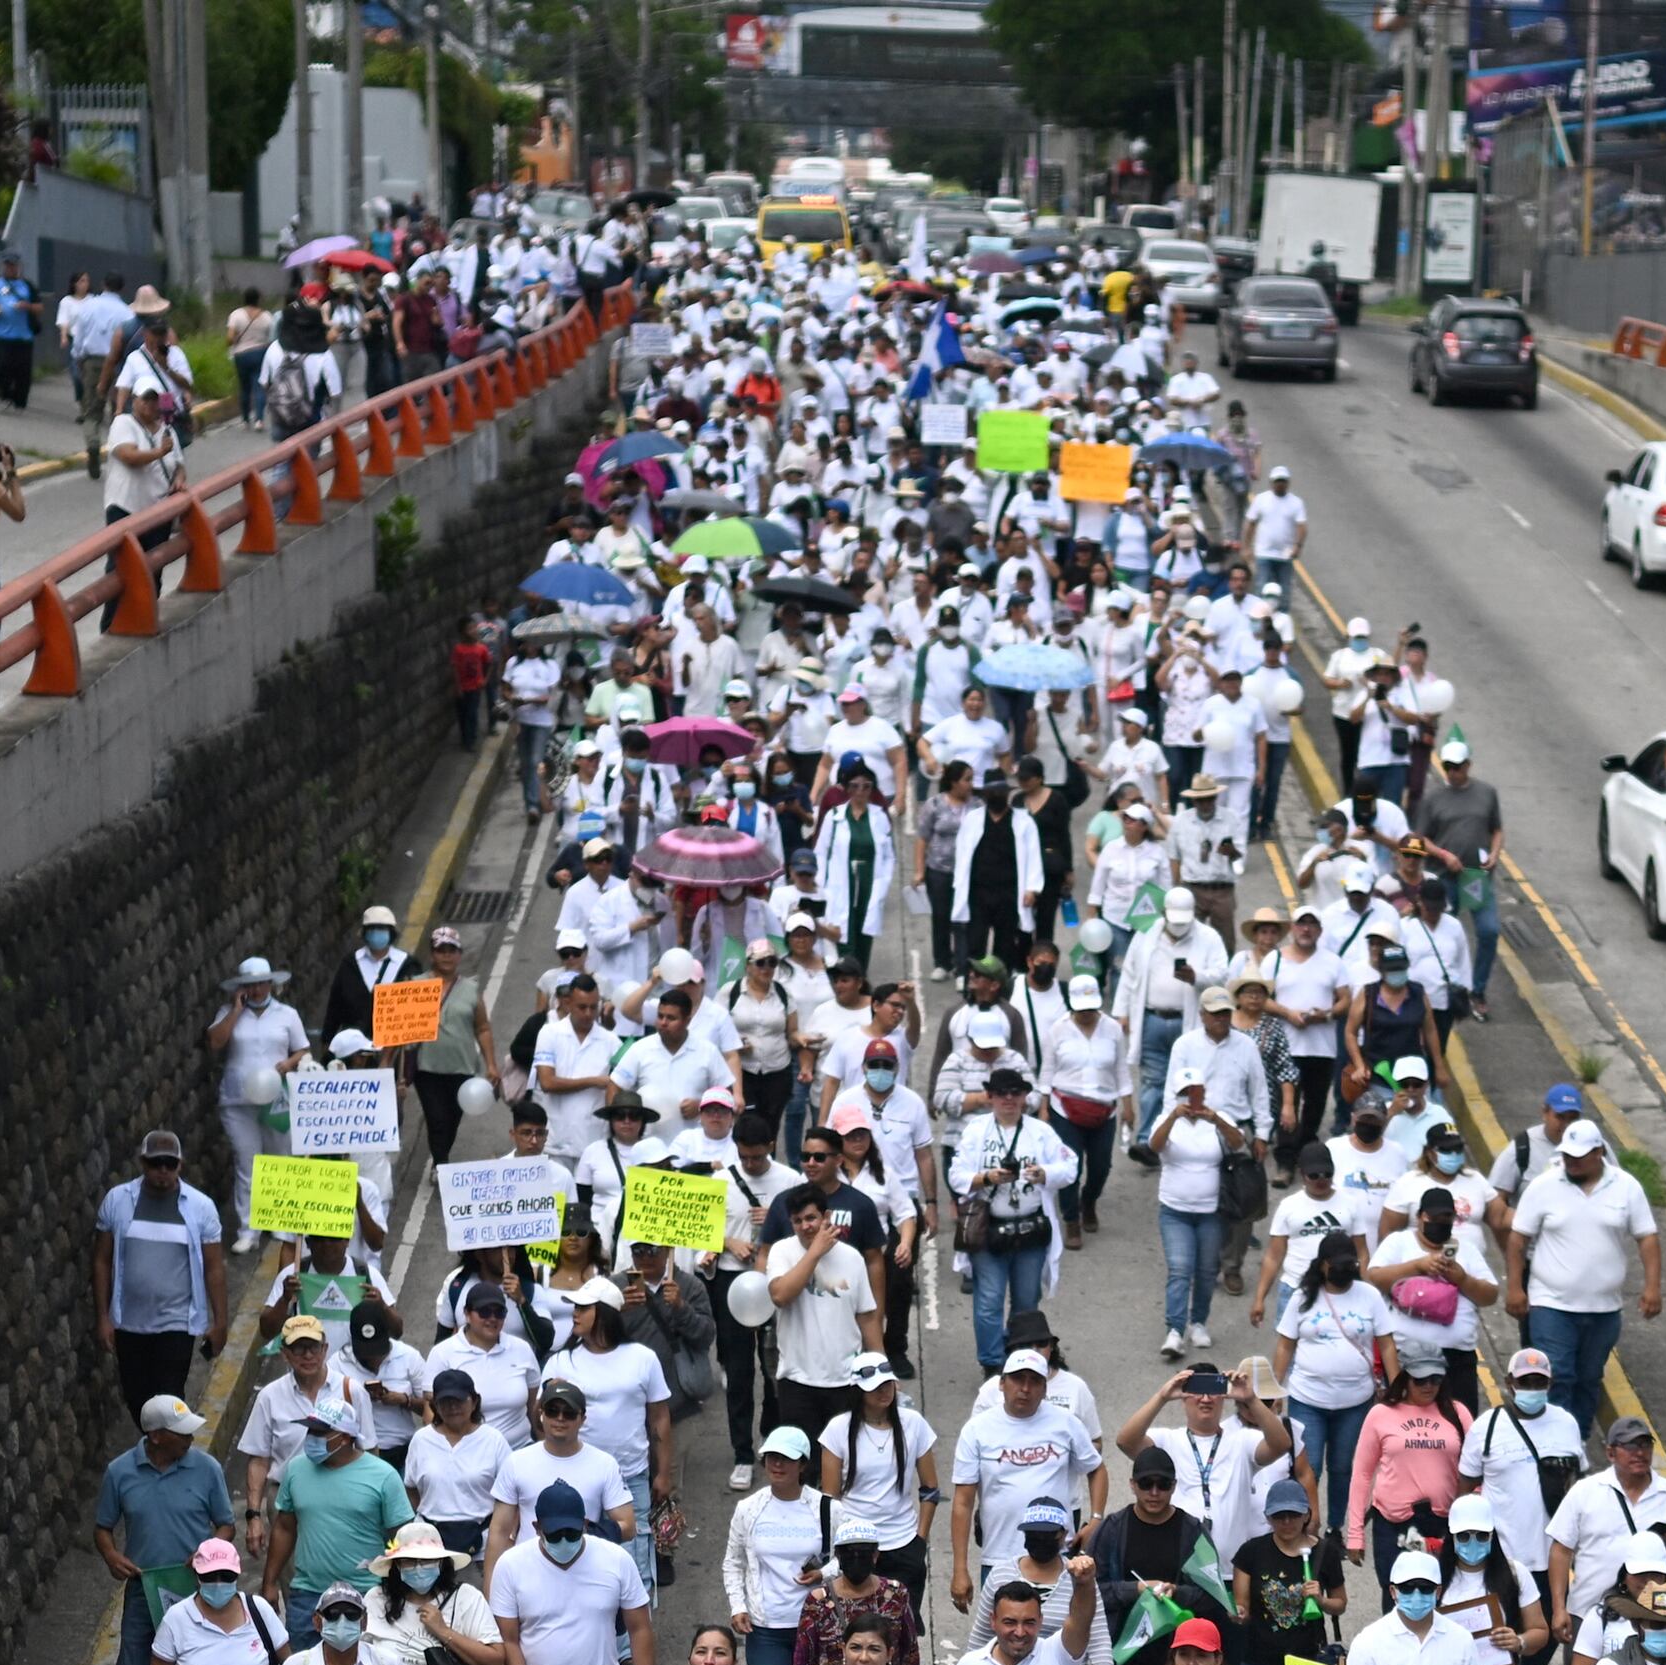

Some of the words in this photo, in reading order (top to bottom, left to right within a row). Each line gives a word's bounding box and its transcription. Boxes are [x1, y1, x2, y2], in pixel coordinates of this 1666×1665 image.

[298, 1080, 380, 1094] ESCALAFON
[298, 1099, 377, 1111] ESCALAFON
[297, 1115, 375, 1127] ESCALAFON
[660, 1176, 684, 1187] POR
[479, 1201, 512, 1214] SOMOS
[517, 1197, 555, 1211] AHORA
[655, 1197, 710, 1213] ESCALAFON
[1401, 1417, 1440, 1432] UNDER
[1405, 1439, 1446, 1450] ARMOUR
